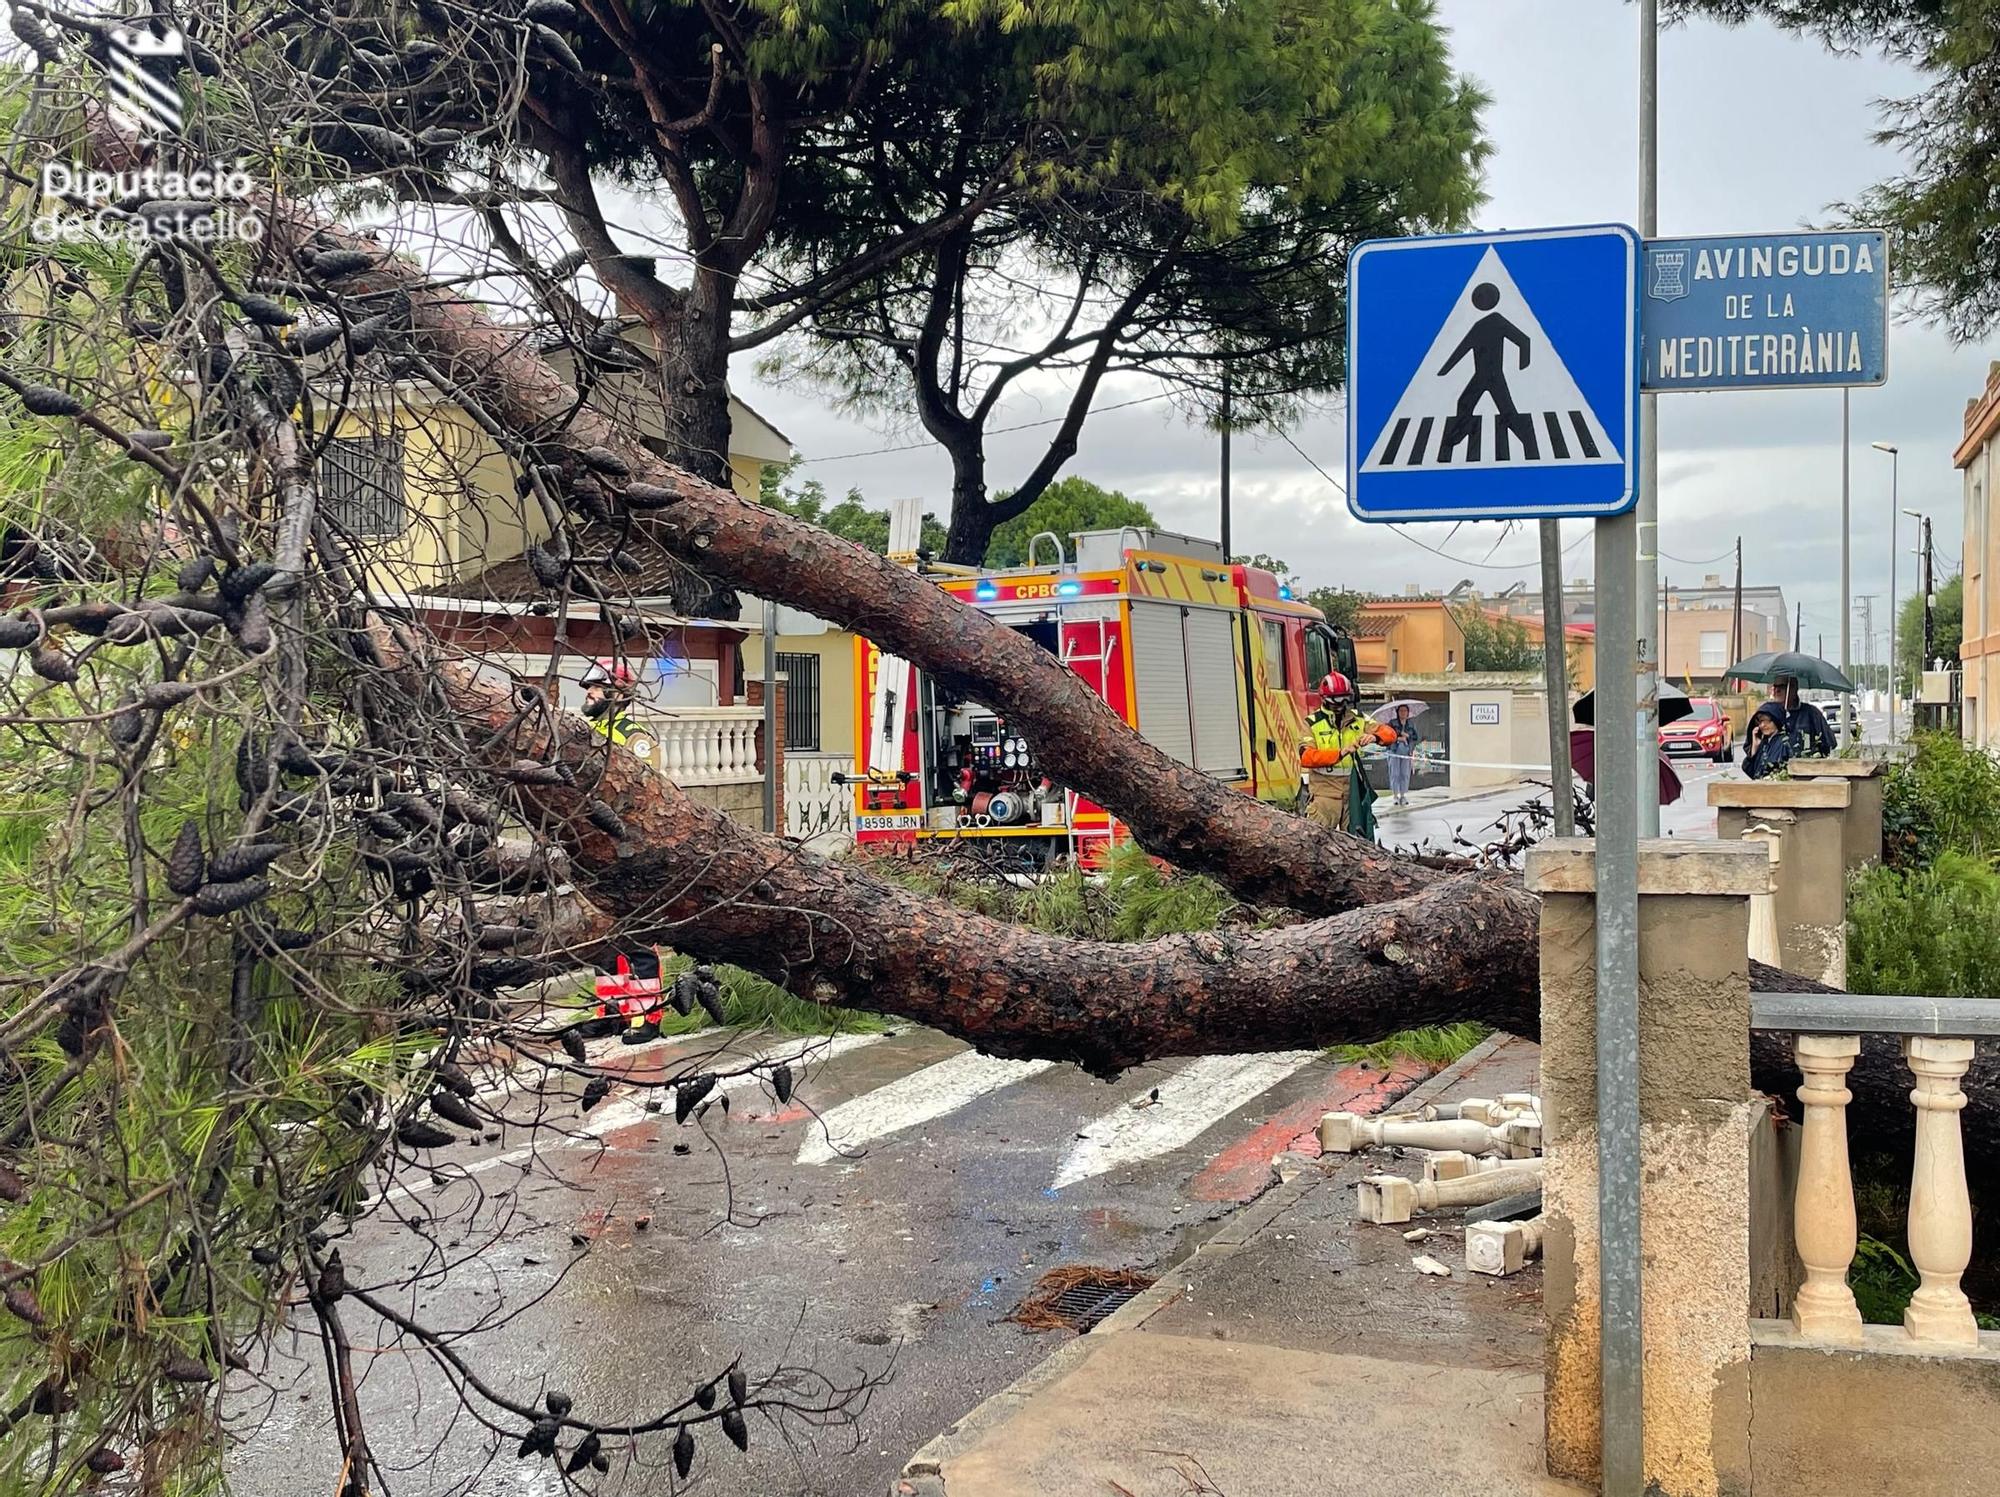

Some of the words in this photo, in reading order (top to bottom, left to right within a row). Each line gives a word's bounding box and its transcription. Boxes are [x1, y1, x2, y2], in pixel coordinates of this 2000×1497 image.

[1694, 244, 1874, 280] AVINGUDA
[1725, 294, 1753, 319] DE
[1767, 293, 1795, 318] LA
[1659, 326, 1862, 379] MEDITERRÀNIA
[864, 817, 893, 829] 8598
[896, 816, 917, 828] JRN
